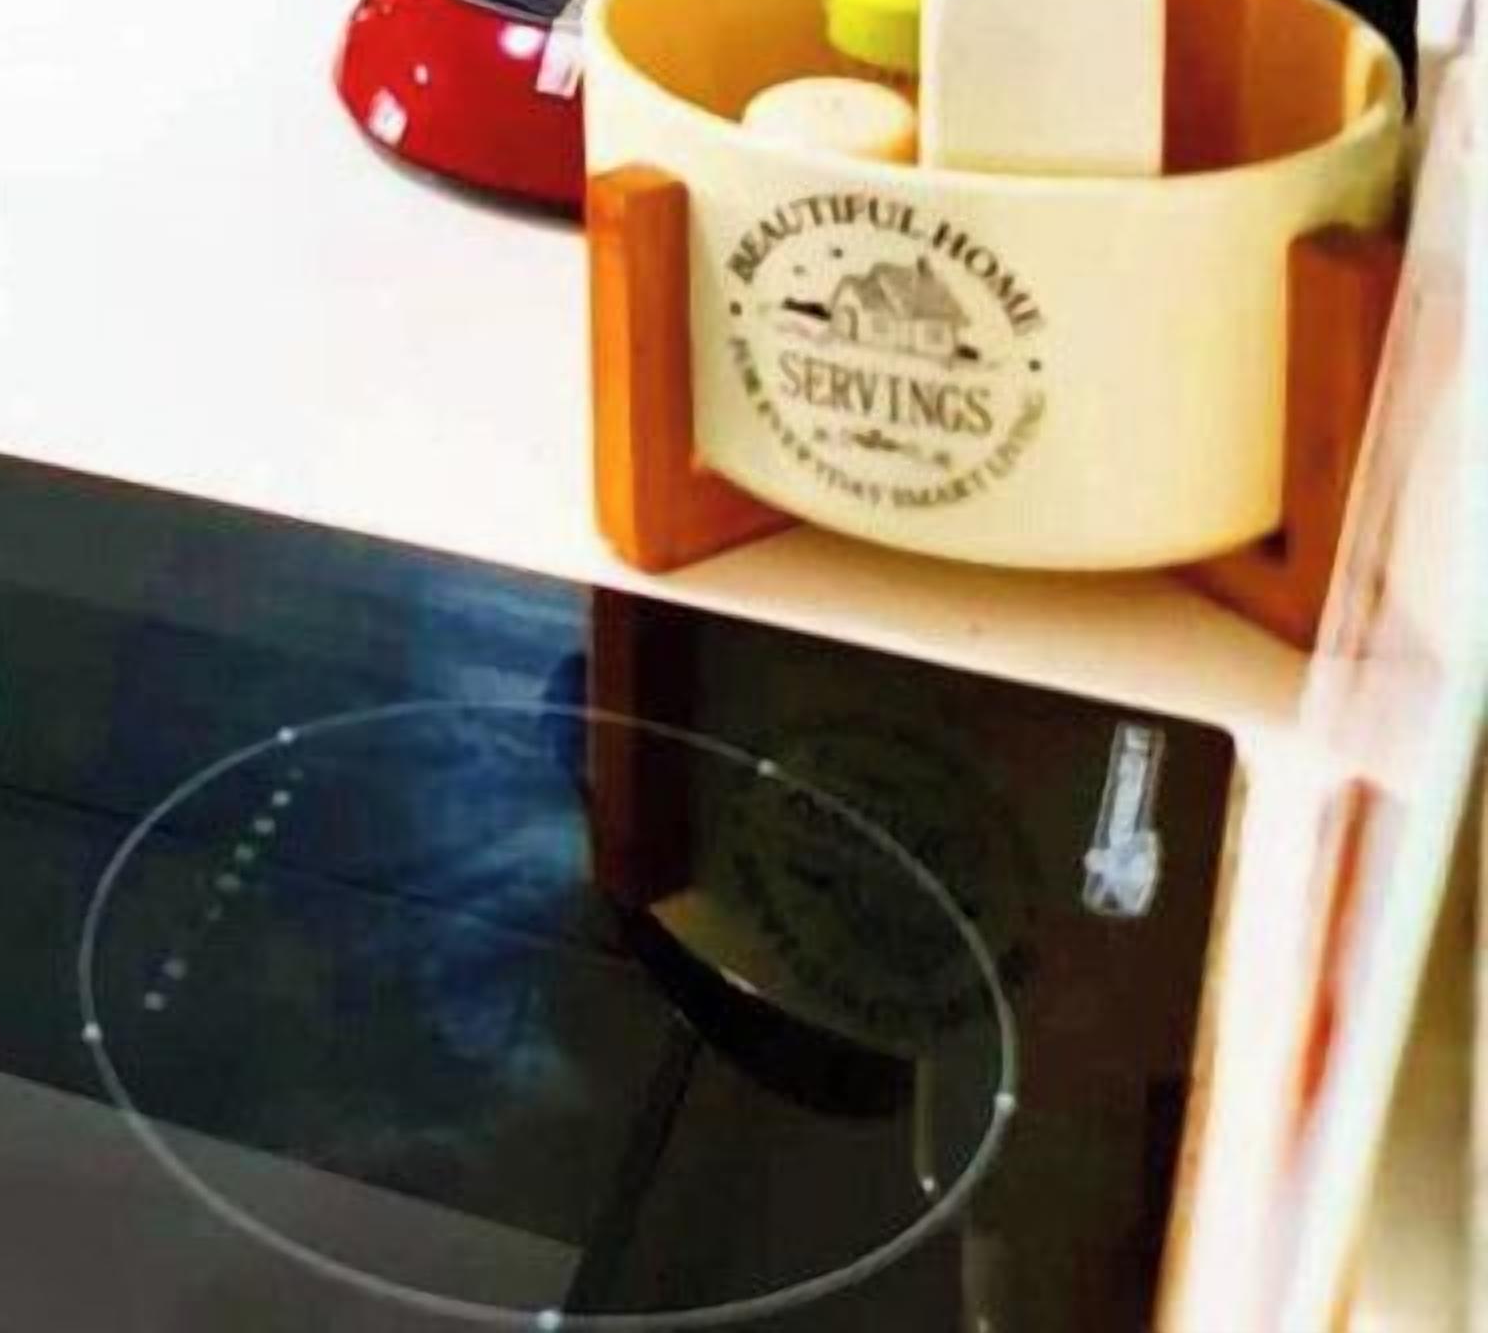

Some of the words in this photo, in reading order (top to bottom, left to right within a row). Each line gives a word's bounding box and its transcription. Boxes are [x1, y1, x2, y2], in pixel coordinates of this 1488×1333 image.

[726, 194, 924, 283] BEAUTIFUL
[932, 221, 1045, 333] HOME
[778, 349, 993, 435] SERVINGS
